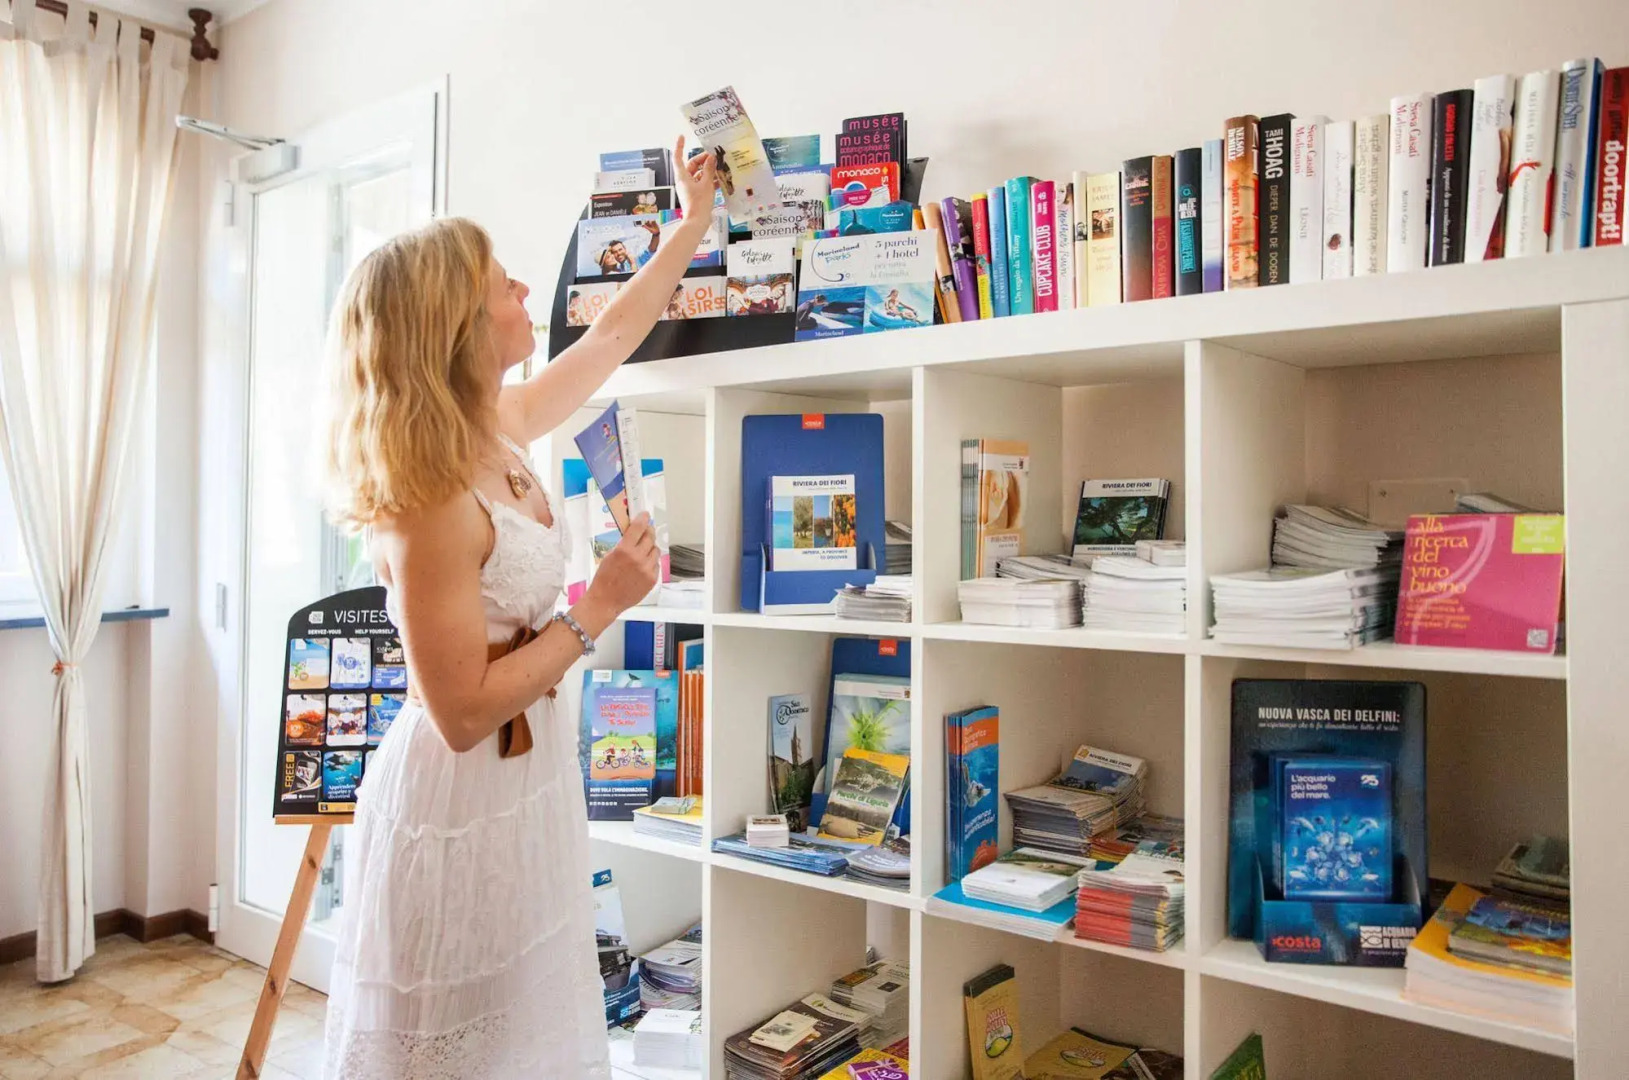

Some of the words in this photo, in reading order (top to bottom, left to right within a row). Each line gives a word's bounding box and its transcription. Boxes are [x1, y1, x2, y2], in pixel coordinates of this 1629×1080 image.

[697, 105, 730, 123] Saison
[1410, 102, 1422, 127] Sveva
[849, 115, 899, 131] musée
[840, 131, 890, 146] musée
[1265, 128, 1284, 137] TAMI
[1307, 124, 1317, 149] Sveva
[1235, 126, 1245, 157] NELSON
[1409, 128, 1421, 158] Casati
[840, 151, 891, 167] monaco
[1265, 137, 1284, 179] HOAG
[1306, 150, 1317, 177] Casati
[837, 167, 880, 178] monaco
[1269, 185, 1278, 211] DIEPER
[1601, 140, 1624, 240] doortrapt!
[766, 214, 803, 225] Saison
[1269, 215, 1278, 234] DAN
[753, 225, 806, 237] coréenne
[1035, 224, 1051, 249] CLUB
[817, 242, 860, 257] Marineland
[884, 236, 918, 251] parchi
[1012, 234, 1021, 259] Tiffany
[1269, 237, 1278, 248] DE
[893, 248, 919, 258] hotel
[1013, 260, 1021, 269] da
[1269, 253, 1278, 284] DODEN
[1014, 270, 1022, 290] regalo
[1035, 251, 1053, 297] CUPCAKE
[685, 286, 713, 304] LOI
[1014, 291, 1022, 303] Un
[1416, 517, 1444, 533] alla
[1414, 535, 1469, 548] ricerca
[1413, 546, 1439, 563] del
[1411, 564, 1449, 578] vino
[1410, 577, 1467, 593] buono
[334, 610, 388, 623] VISITES
[1258, 707, 1293, 720] NUOVA
[1296, 708, 1331, 720] VASCA
[1333, 709, 1351, 721] DEI
[1355, 710, 1400, 723] DELFINI:
[284, 762, 295, 788] FREE
[1291, 774, 1336, 783] L'acquario
[1291, 783, 1305, 792] più
[1306, 783, 1328, 791] bello
[1291, 791, 1305, 799] del
[1278, 935, 1322, 949] costa
